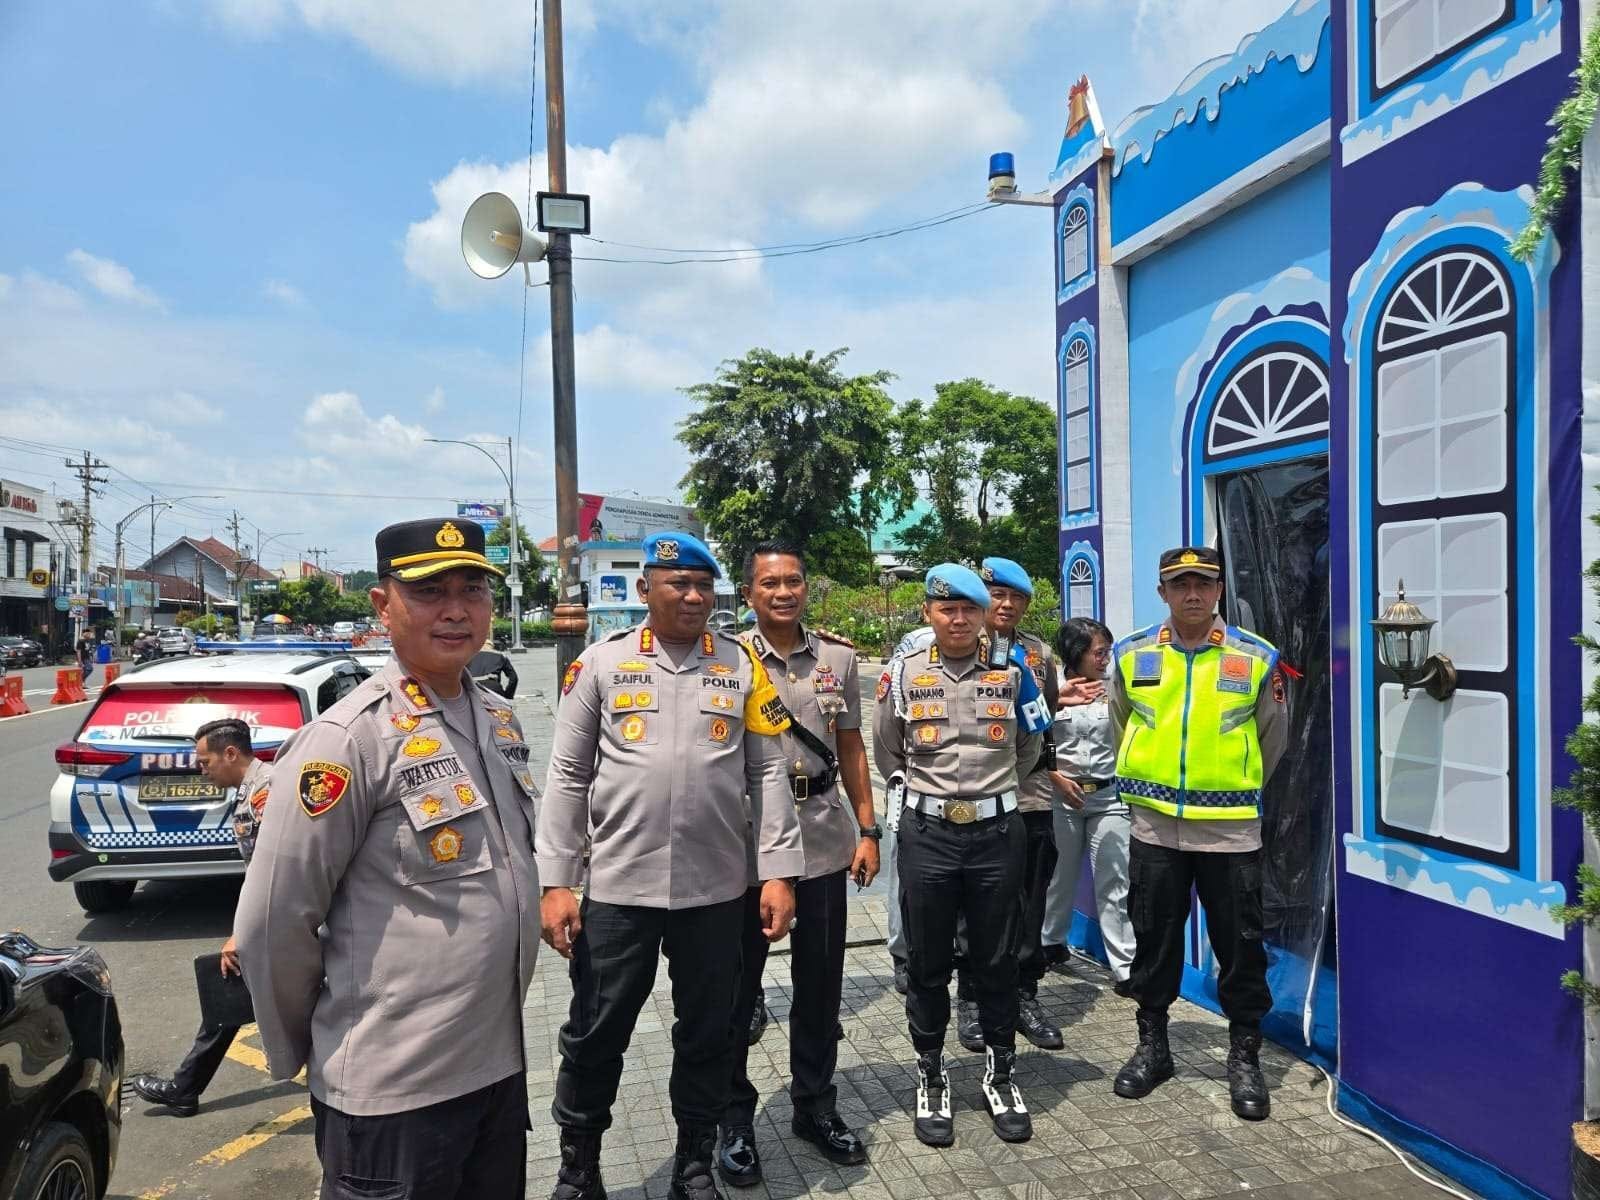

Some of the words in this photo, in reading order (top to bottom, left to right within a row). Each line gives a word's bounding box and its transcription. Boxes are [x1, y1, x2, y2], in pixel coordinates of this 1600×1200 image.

[464, 508, 490, 516] Mitra
[613, 674, 654, 685] SAIFUL
[702, 677, 740, 690] POLRI
[977, 687, 1013, 700] POLRI
[401, 757, 463, 788] WAHYUDI
